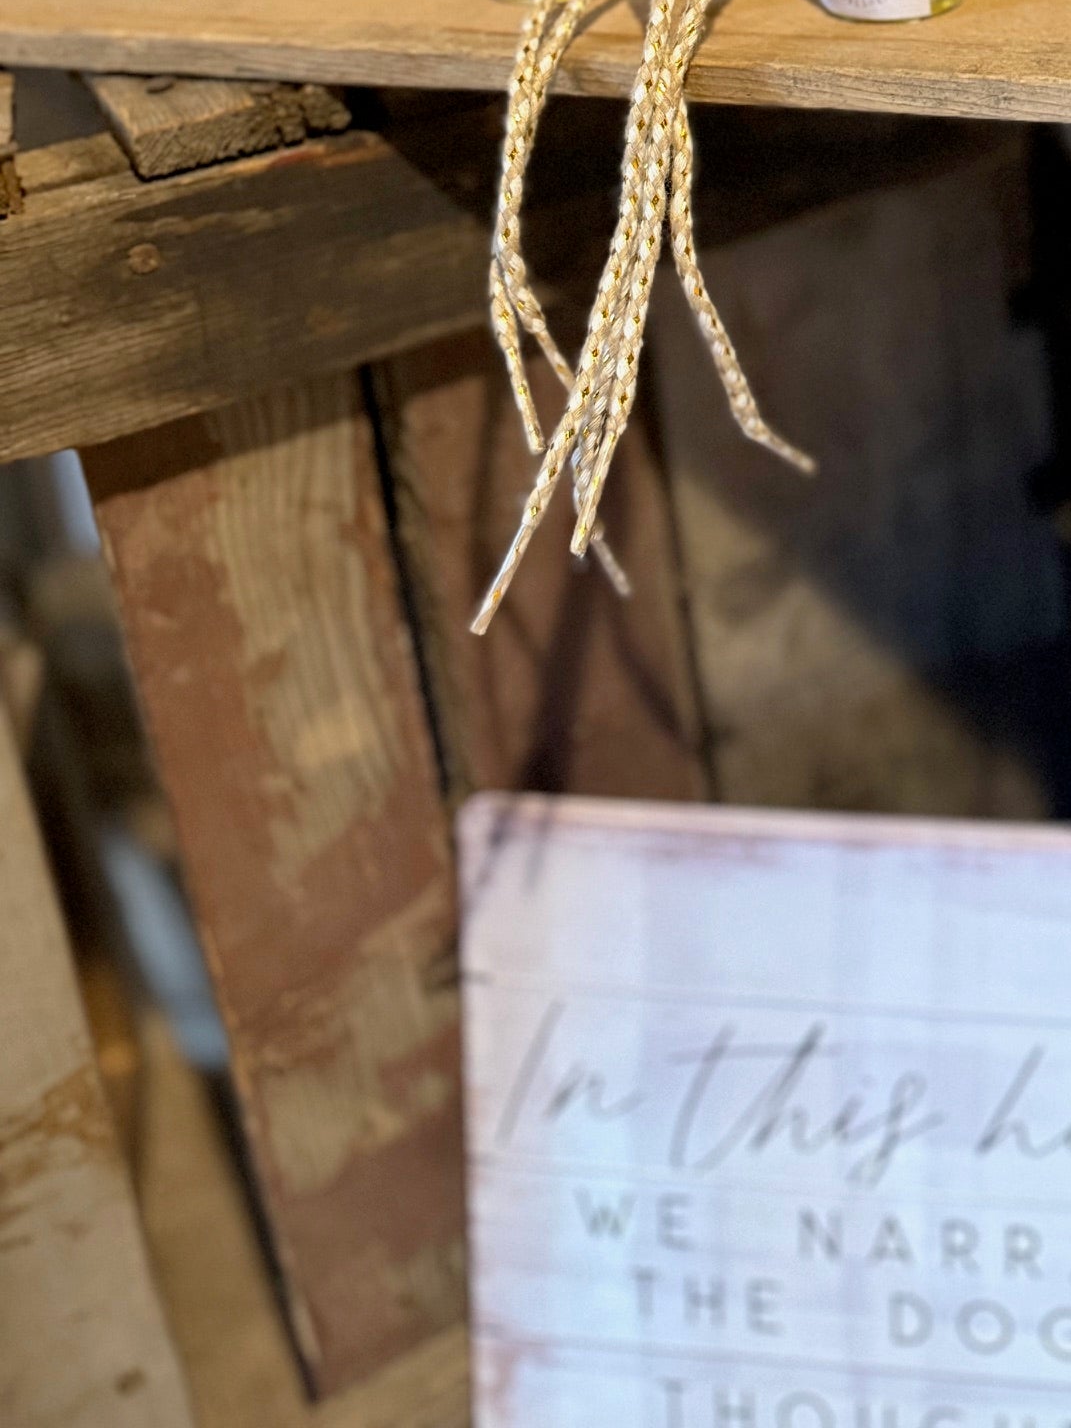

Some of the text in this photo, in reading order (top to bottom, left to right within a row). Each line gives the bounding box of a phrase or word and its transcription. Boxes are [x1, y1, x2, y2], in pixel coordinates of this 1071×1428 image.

[496, 999, 644, 1150] In
[666, 1022, 940, 1188] this
[575, 1190, 696, 1254] WE
[630, 1264, 783, 1335] THE
